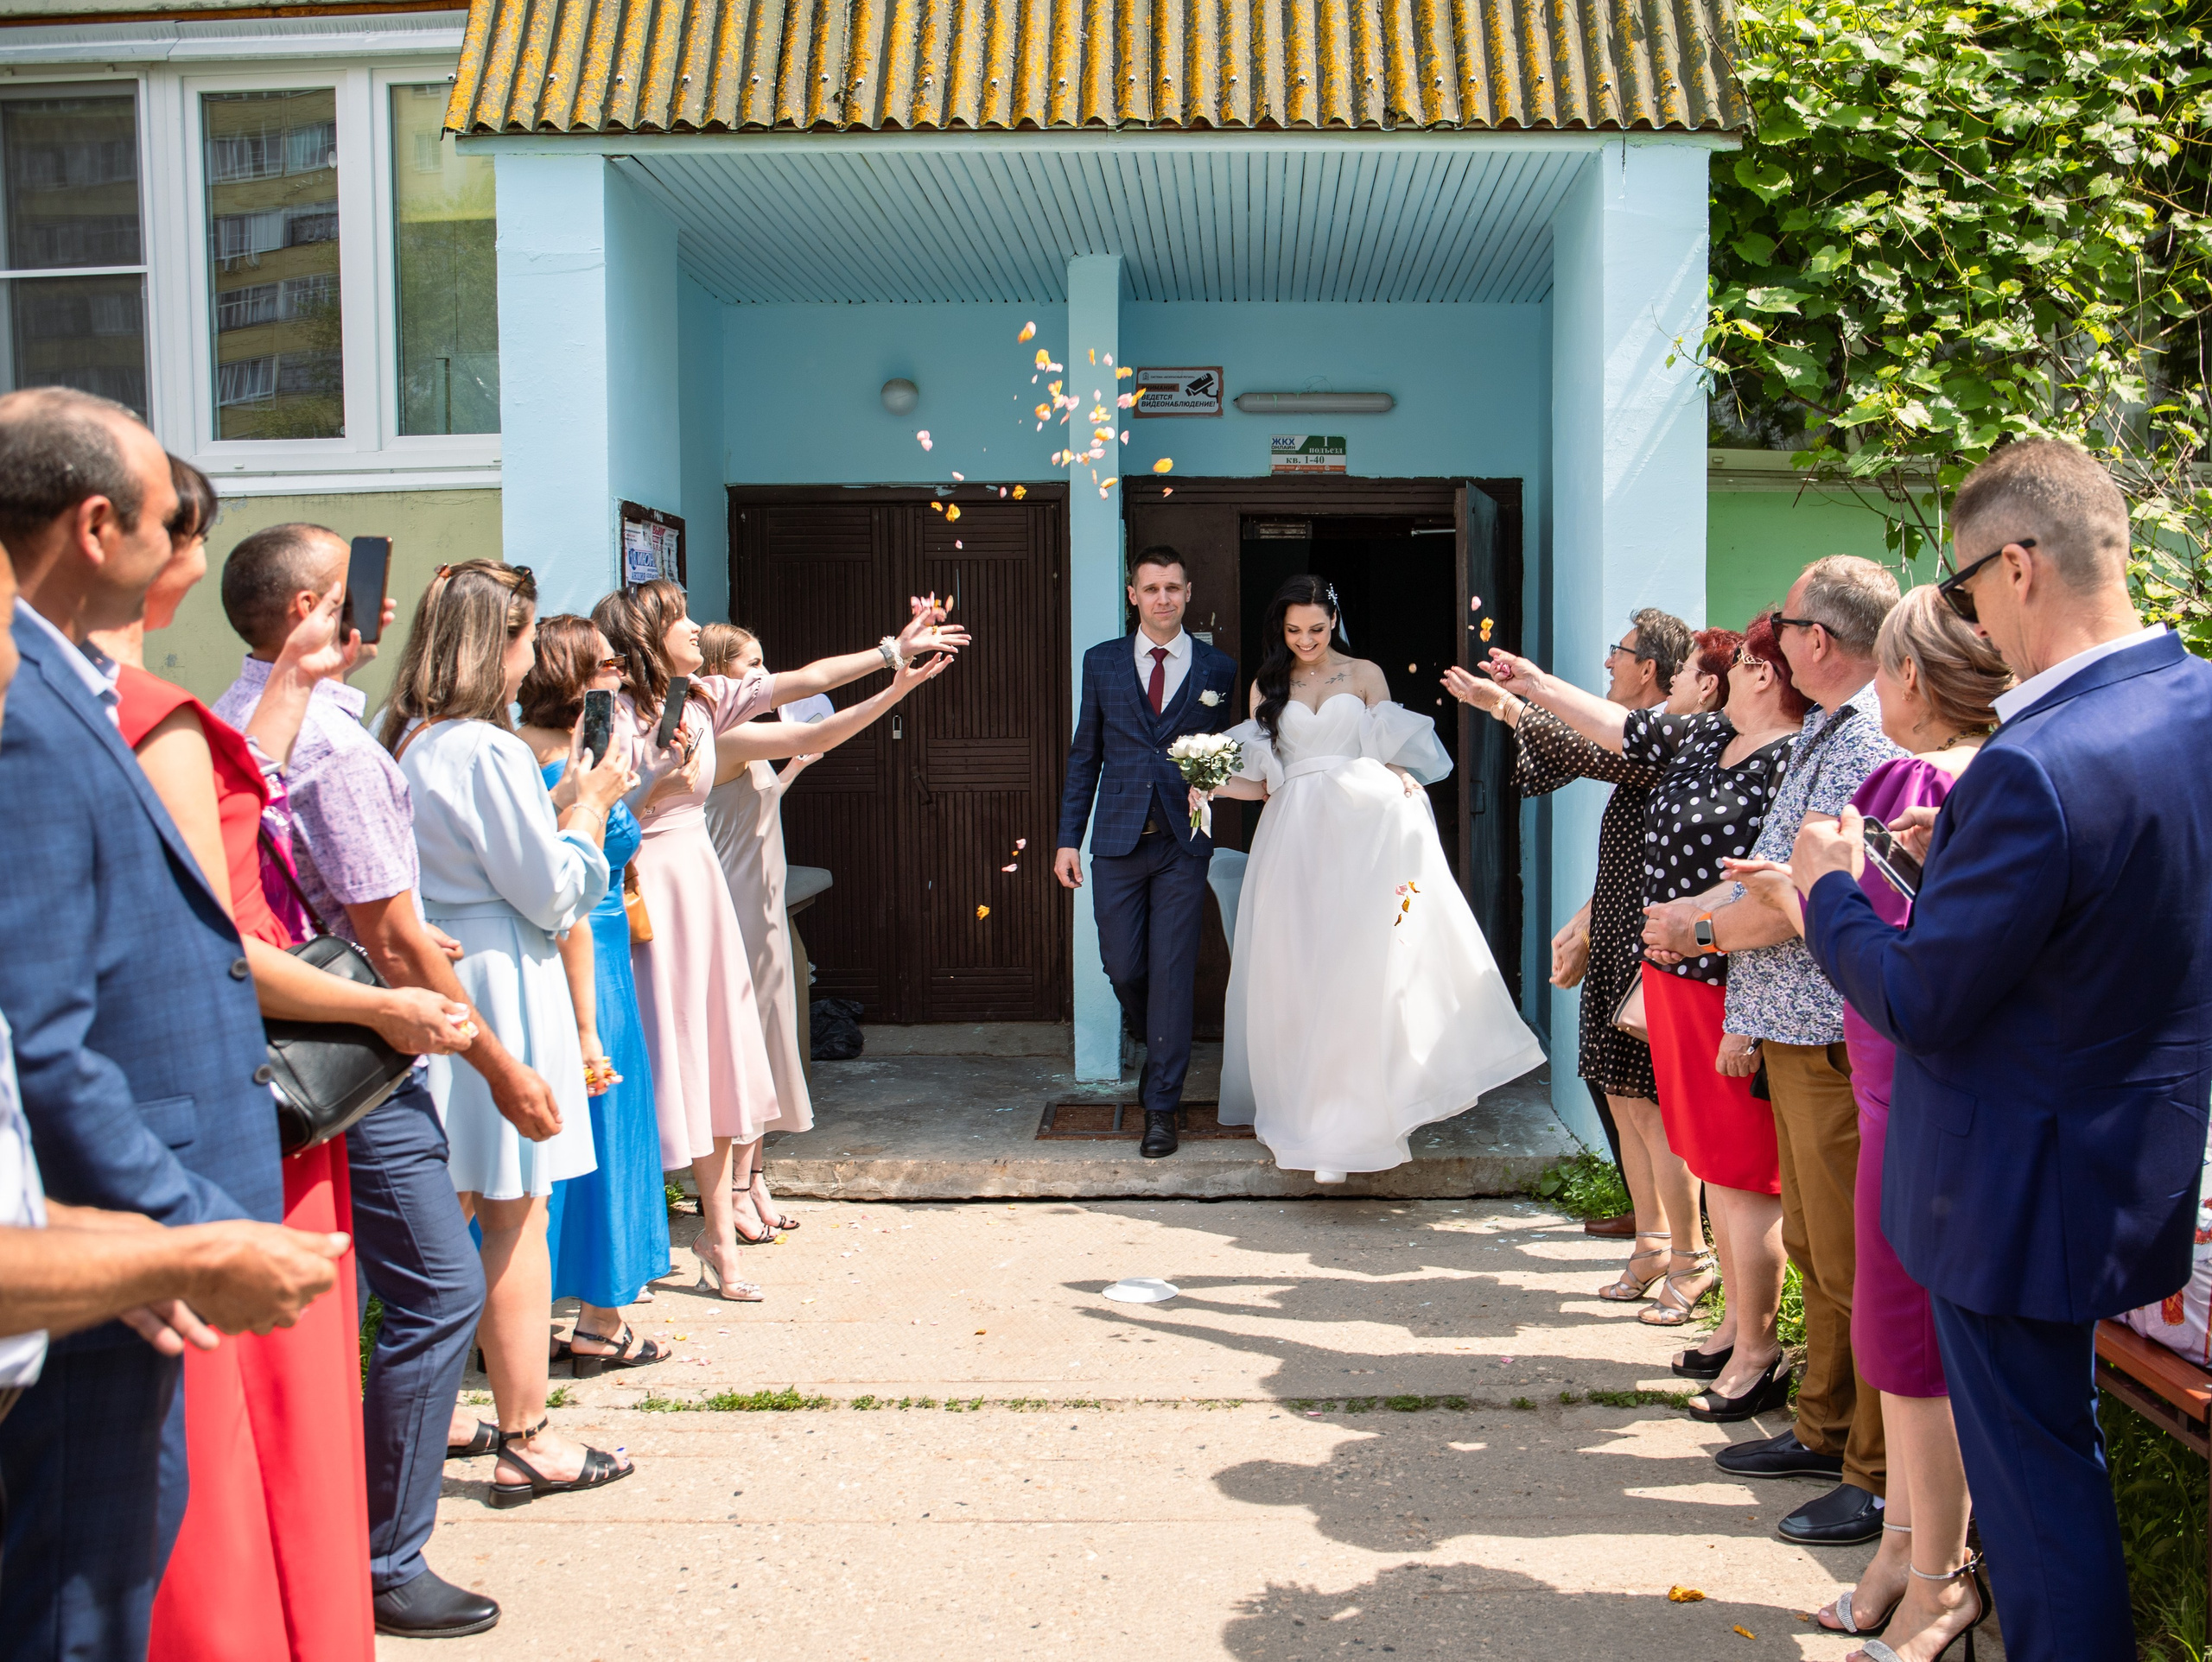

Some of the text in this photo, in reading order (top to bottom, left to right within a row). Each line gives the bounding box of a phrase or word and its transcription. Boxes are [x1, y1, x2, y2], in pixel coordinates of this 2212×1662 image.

[1272, 437, 1295, 446] ЖКХ
[1323, 436, 1328, 447] 1
[1305, 455, 1325, 464] 1-40
